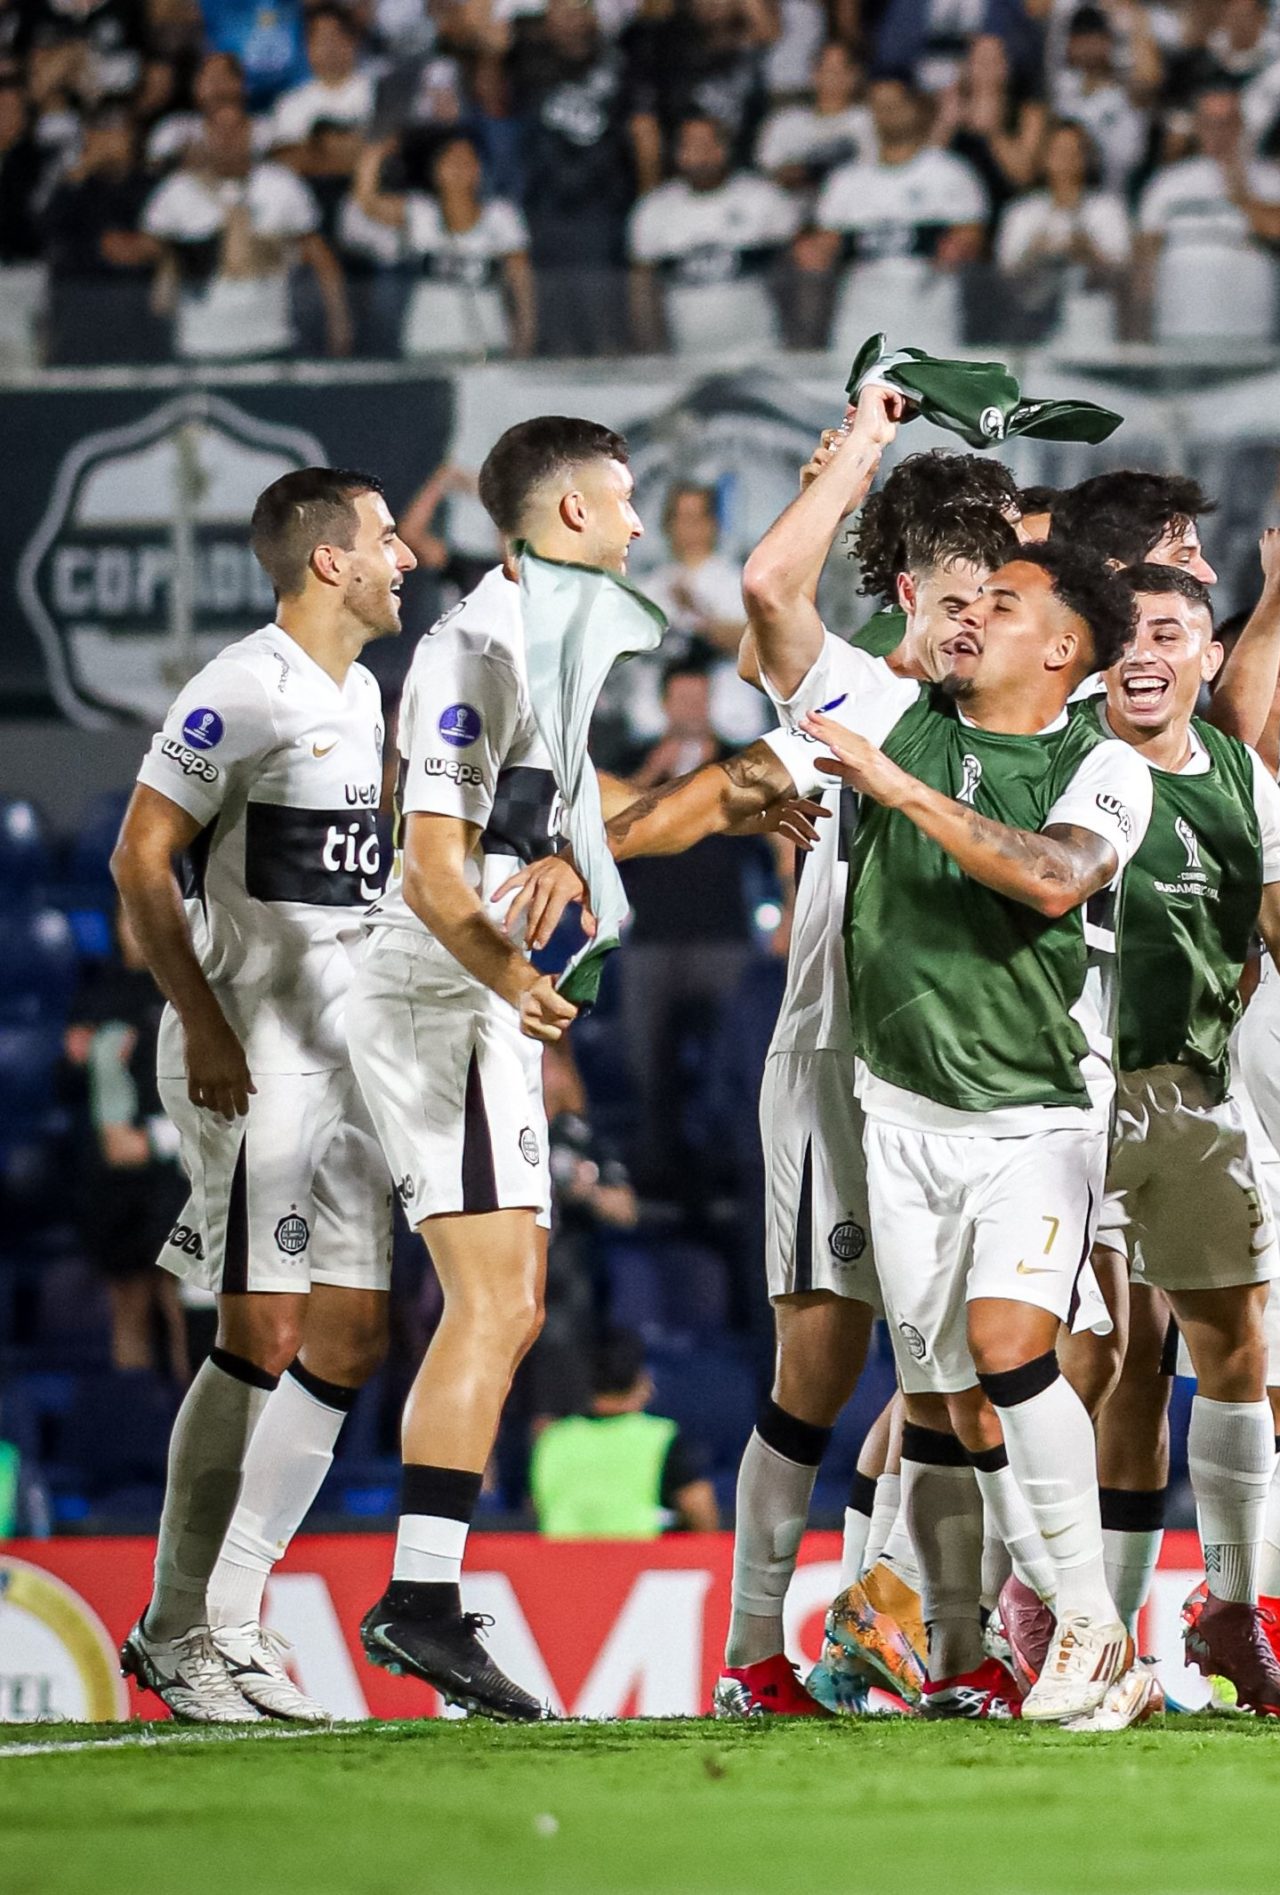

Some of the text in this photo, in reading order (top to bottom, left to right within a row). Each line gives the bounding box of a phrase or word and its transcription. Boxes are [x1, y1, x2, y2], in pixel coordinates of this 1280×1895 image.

[162, 739, 219, 783] wepa
[424, 757, 484, 785] wepa
[322, 822, 382, 901] tig
[1041, 1215, 1060, 1255] 7
